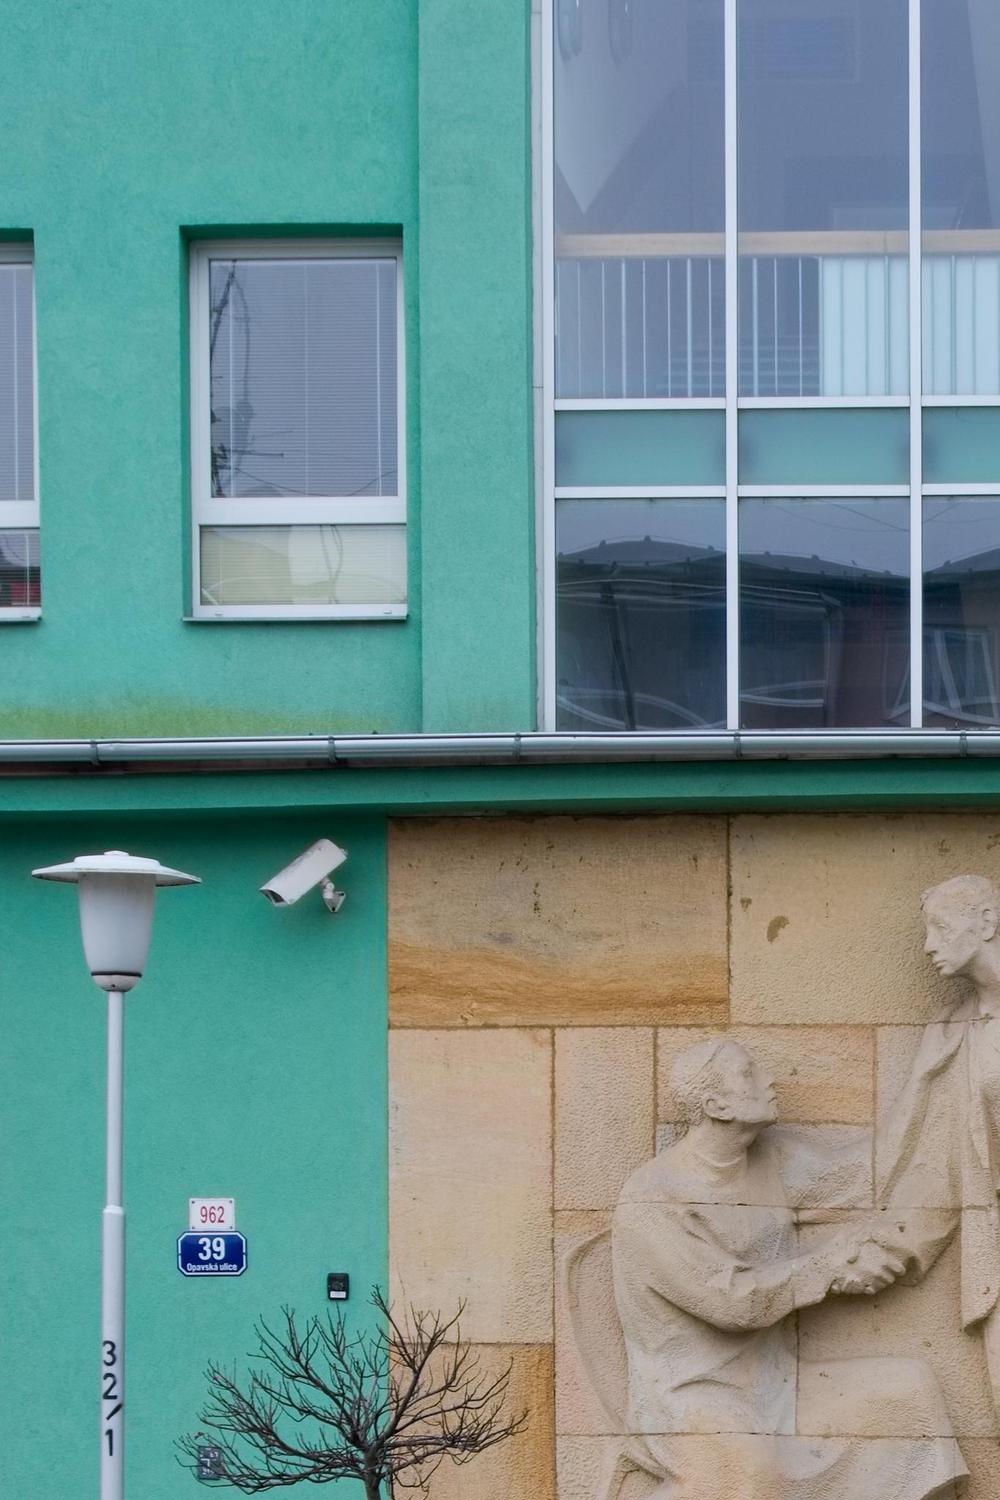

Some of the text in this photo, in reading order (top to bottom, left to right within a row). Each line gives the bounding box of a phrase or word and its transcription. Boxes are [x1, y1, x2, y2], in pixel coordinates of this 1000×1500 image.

[200, 1206, 225, 1223] 962
[198, 1237, 225, 1261] 39
[186, 1263, 238, 1272] Opavská ulice
